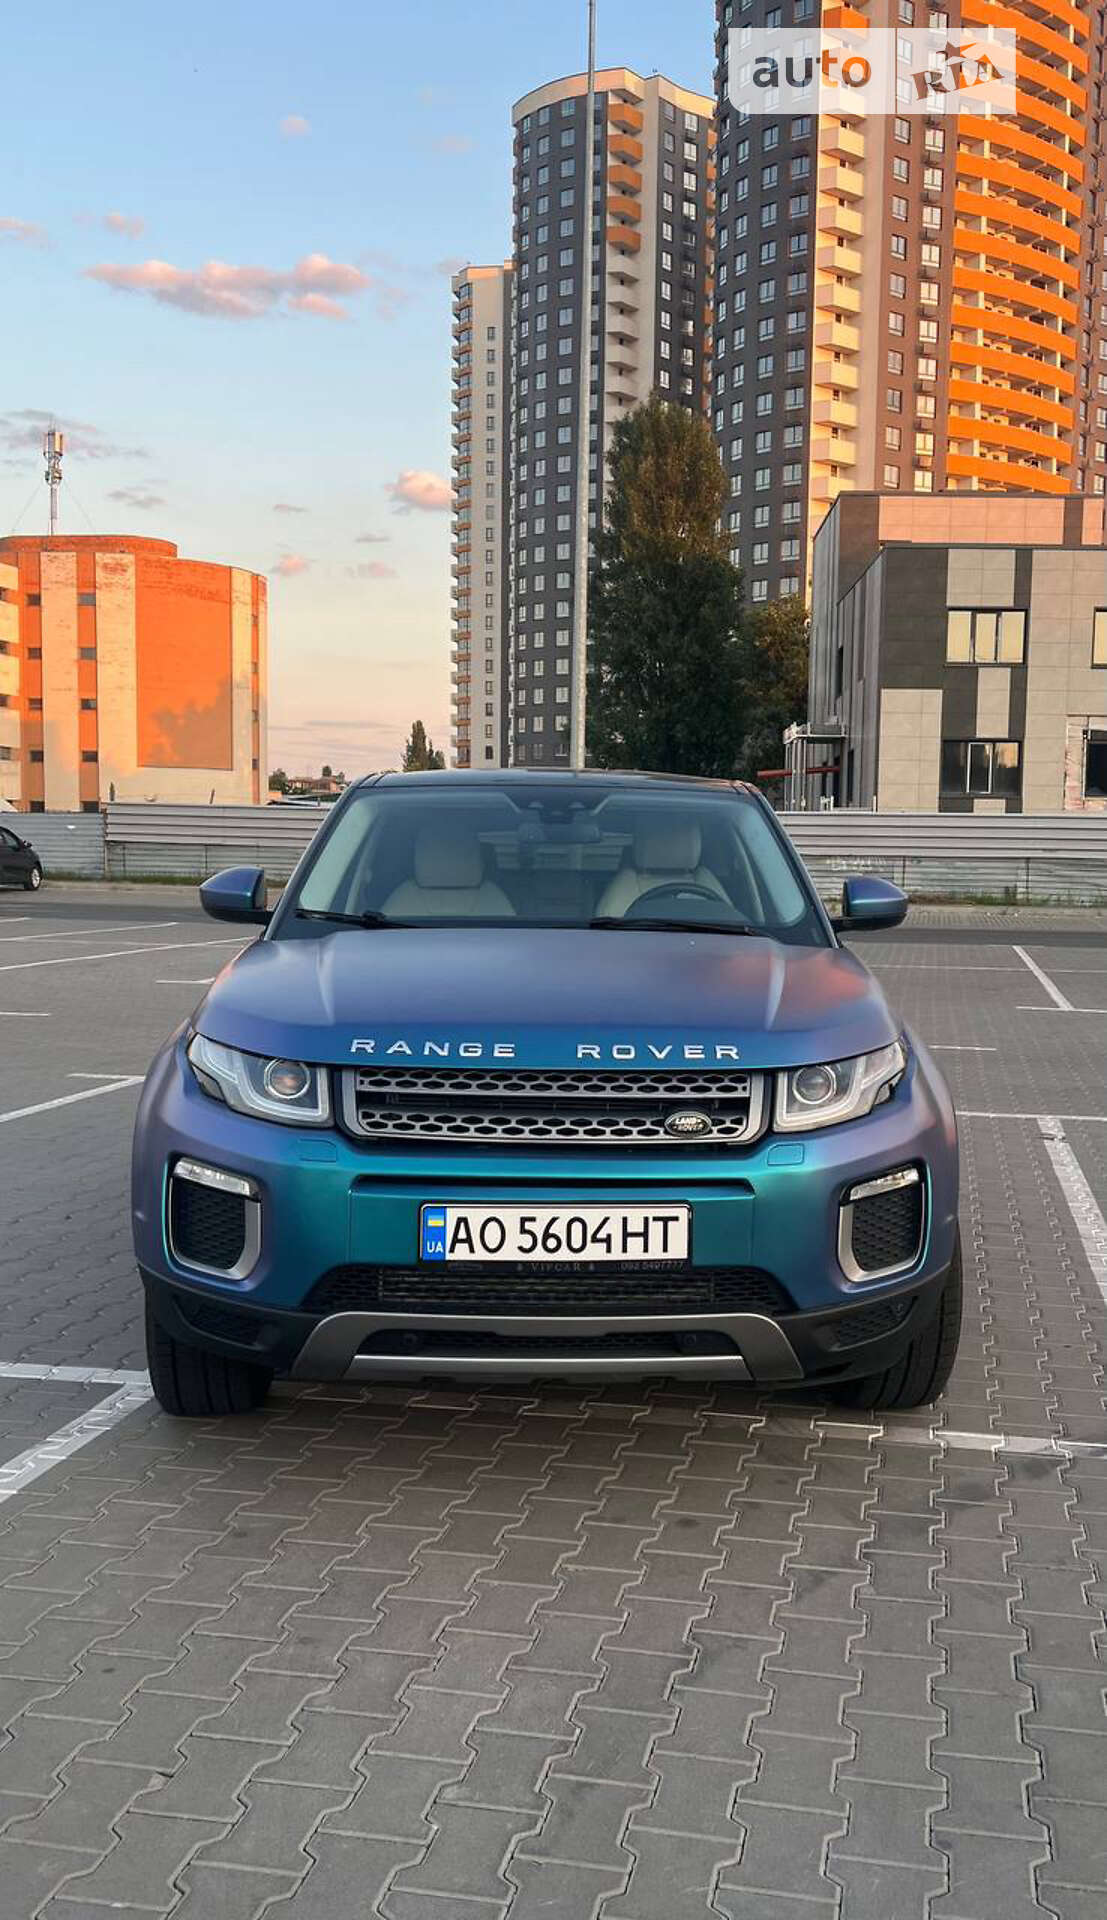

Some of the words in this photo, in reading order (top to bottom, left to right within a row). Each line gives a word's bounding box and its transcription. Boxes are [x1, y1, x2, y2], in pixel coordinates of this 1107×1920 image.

[350, 1039, 517, 1058] RANGE
[576, 1044, 741, 1060] ROVER
[448, 1216, 507, 1254] AO
[516, 1216, 613, 1254] 5604
[621, 1215, 680, 1254] HT
[426, 1240, 444, 1253] UA
